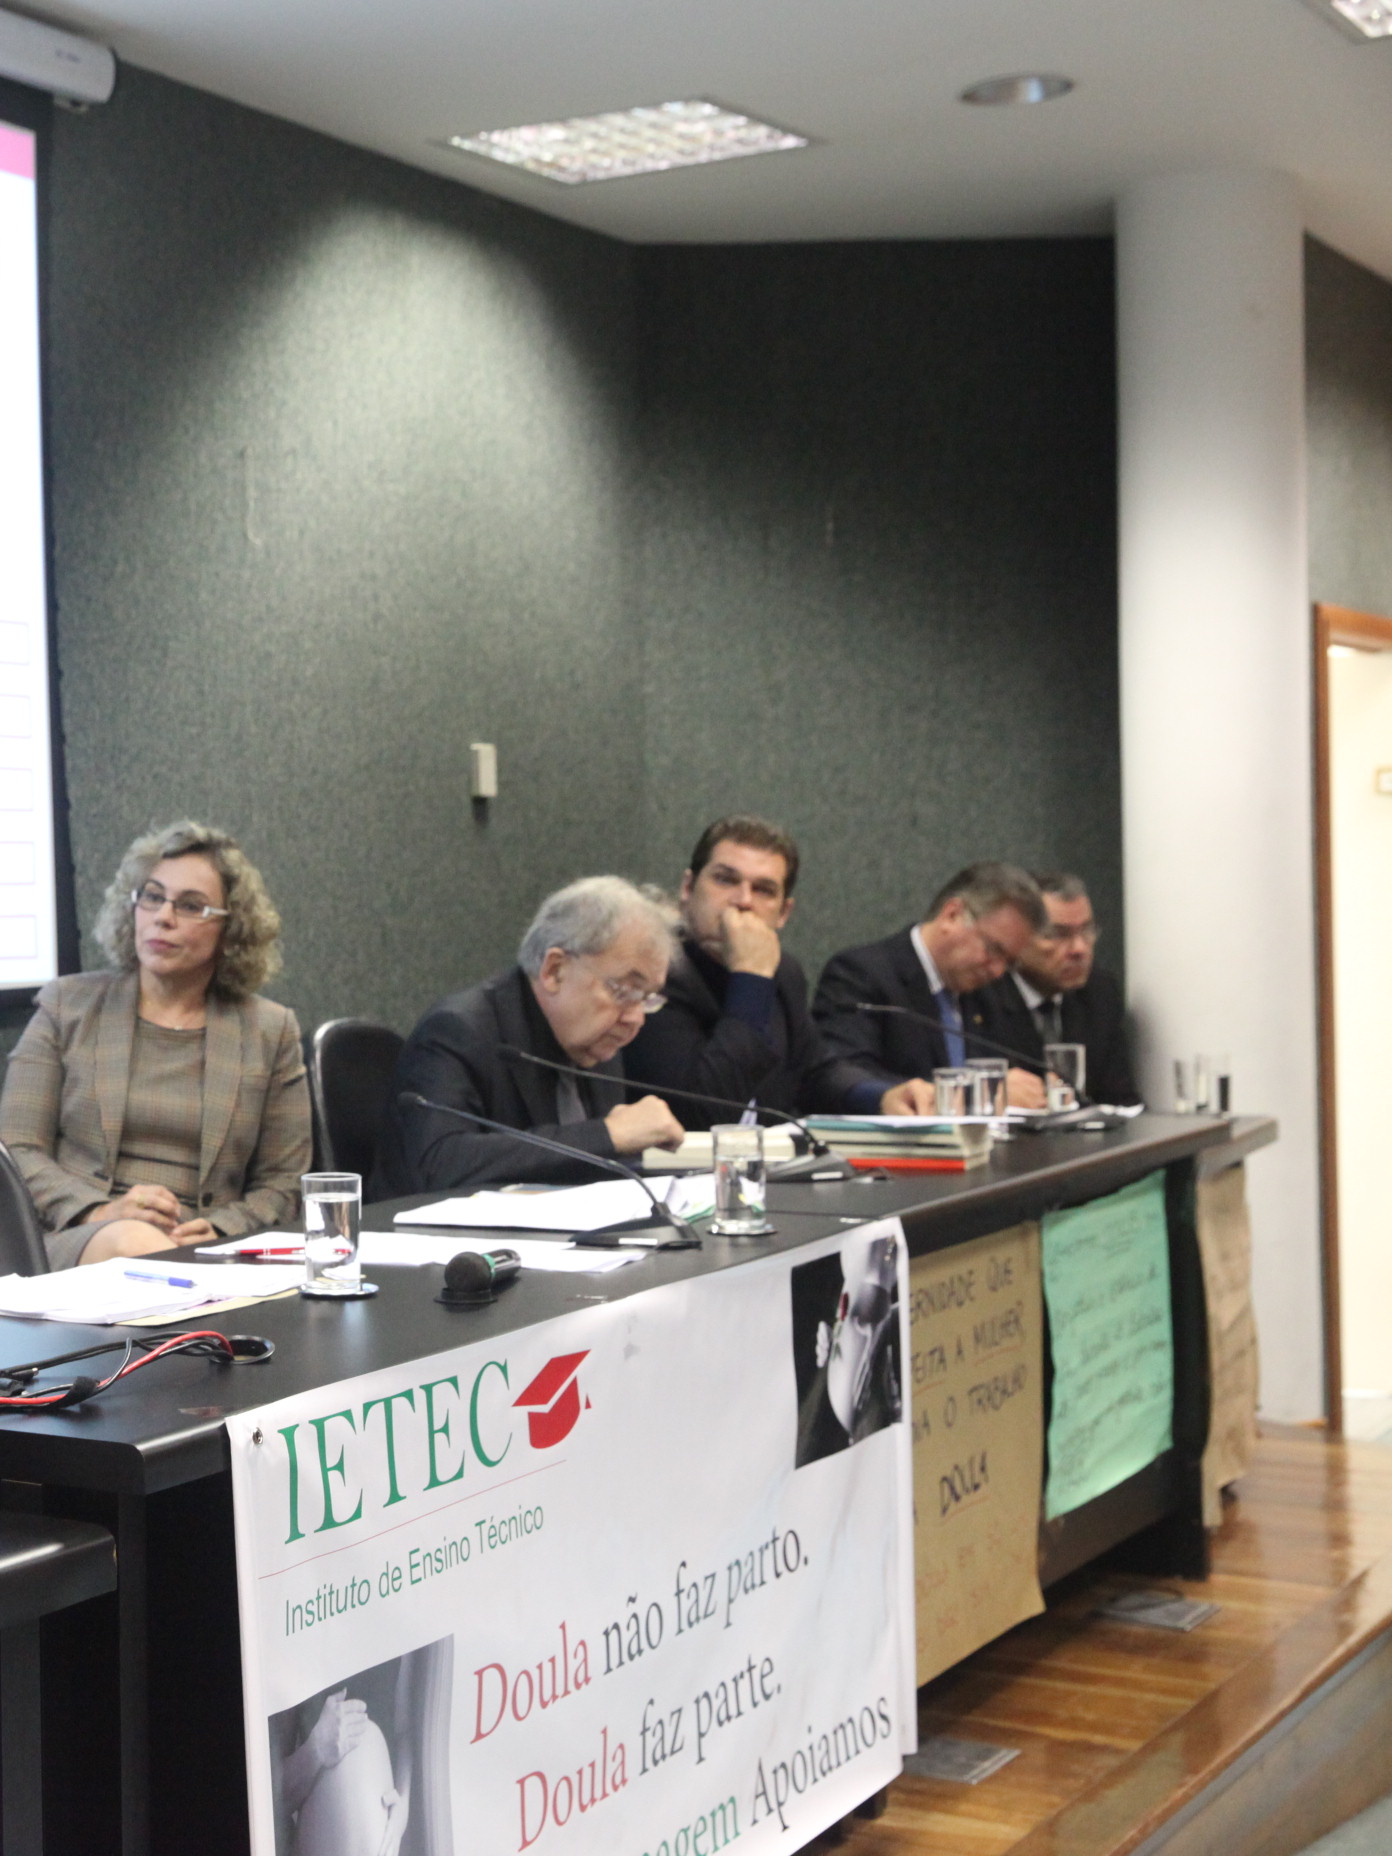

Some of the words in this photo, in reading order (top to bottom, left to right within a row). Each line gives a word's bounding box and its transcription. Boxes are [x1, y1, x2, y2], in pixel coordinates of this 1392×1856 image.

[276, 1357, 514, 1546] IETEC
[285, 1572, 371, 1638] Instituto
[377, 1561, 404, 1600] de
[408, 1525, 472, 1587] Ensino
[475, 1503, 545, 1556] Técnico
[468, 1620, 593, 1746] Doula
[601, 1593, 665, 1677] não
[673, 1561, 718, 1637] faz
[723, 1524, 810, 1628] parto.
[514, 1726, 630, 1853] Doula
[637, 1697, 687, 1778] faz
[694, 1654, 783, 1766] parte.
[749, 1695, 893, 1833] Apoiamos
